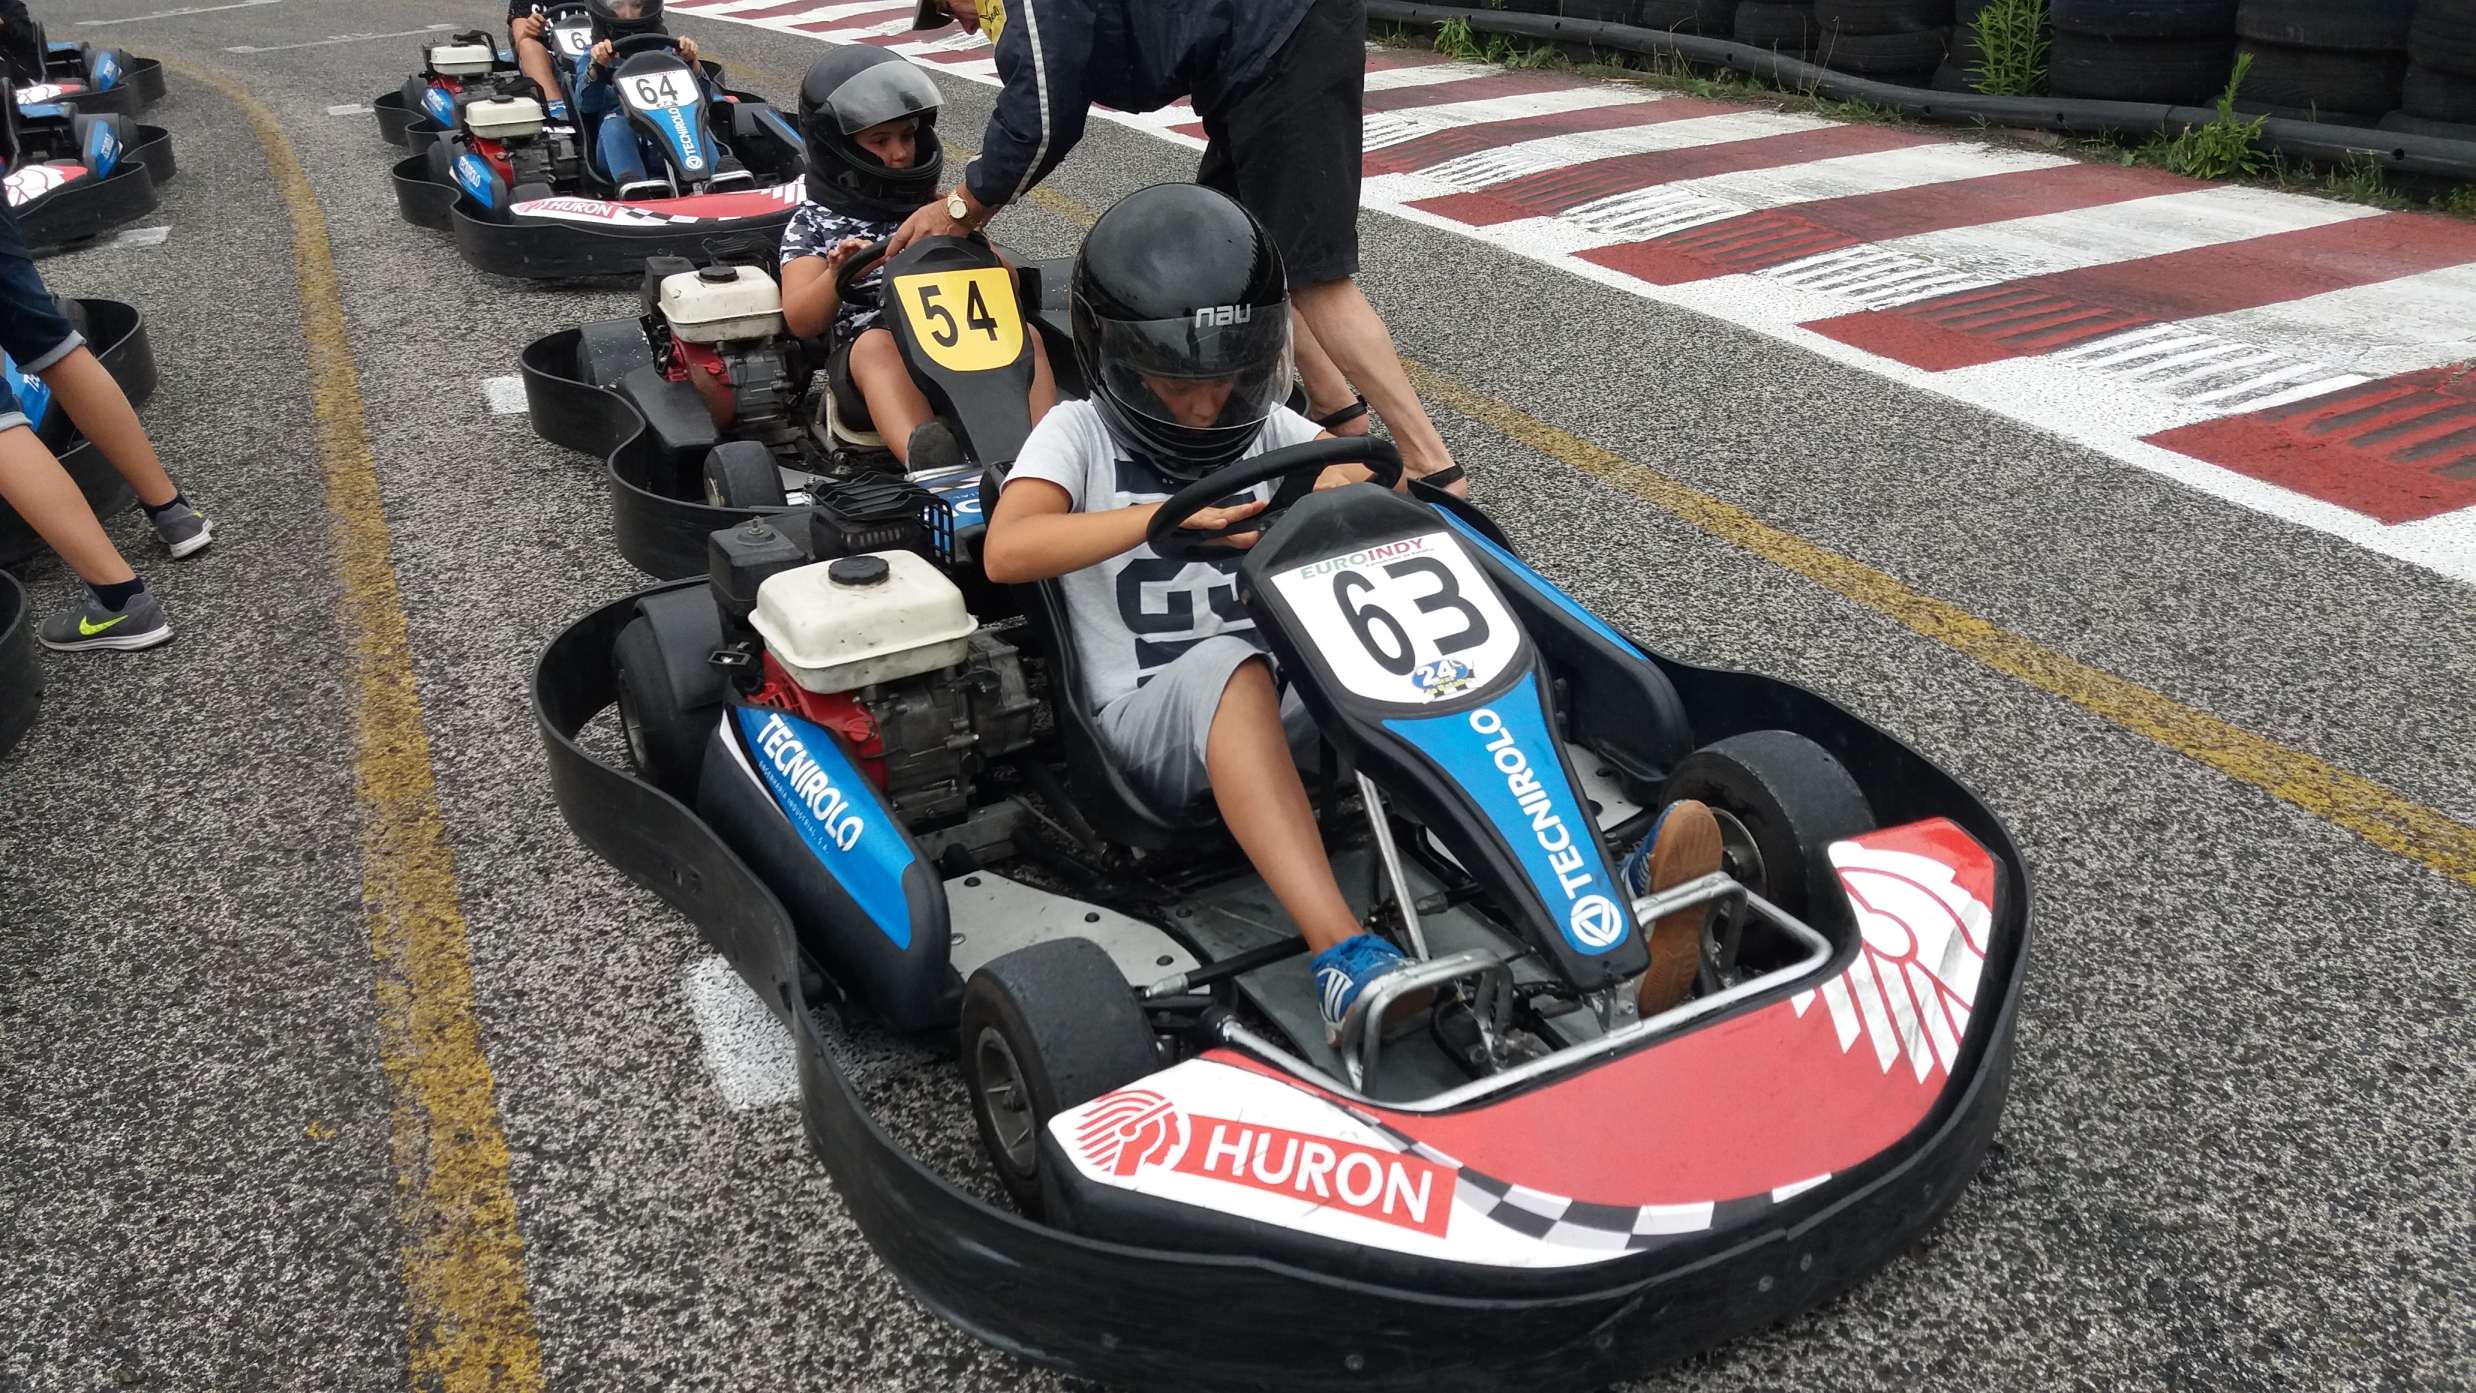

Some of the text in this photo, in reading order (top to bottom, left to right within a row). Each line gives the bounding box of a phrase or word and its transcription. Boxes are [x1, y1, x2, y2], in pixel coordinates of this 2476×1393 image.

[571, 32, 592, 50] 6
[636, 75, 678, 104] 64
[668, 107, 696, 156] TECNIROLO
[548, 201, 614, 217] HURON
[918, 280, 998, 348] 54
[1195, 303, 1251, 328] nau
[1300, 538, 1423, 580] EUROINDY
[1333, 556, 1490, 676] 63
[1416, 660, 1457, 687] 24
[756, 713, 864, 852] TECNIROLO
[1469, 708, 1593, 900] TECNIROLO
[1204, 1125, 1433, 1224] HURON
